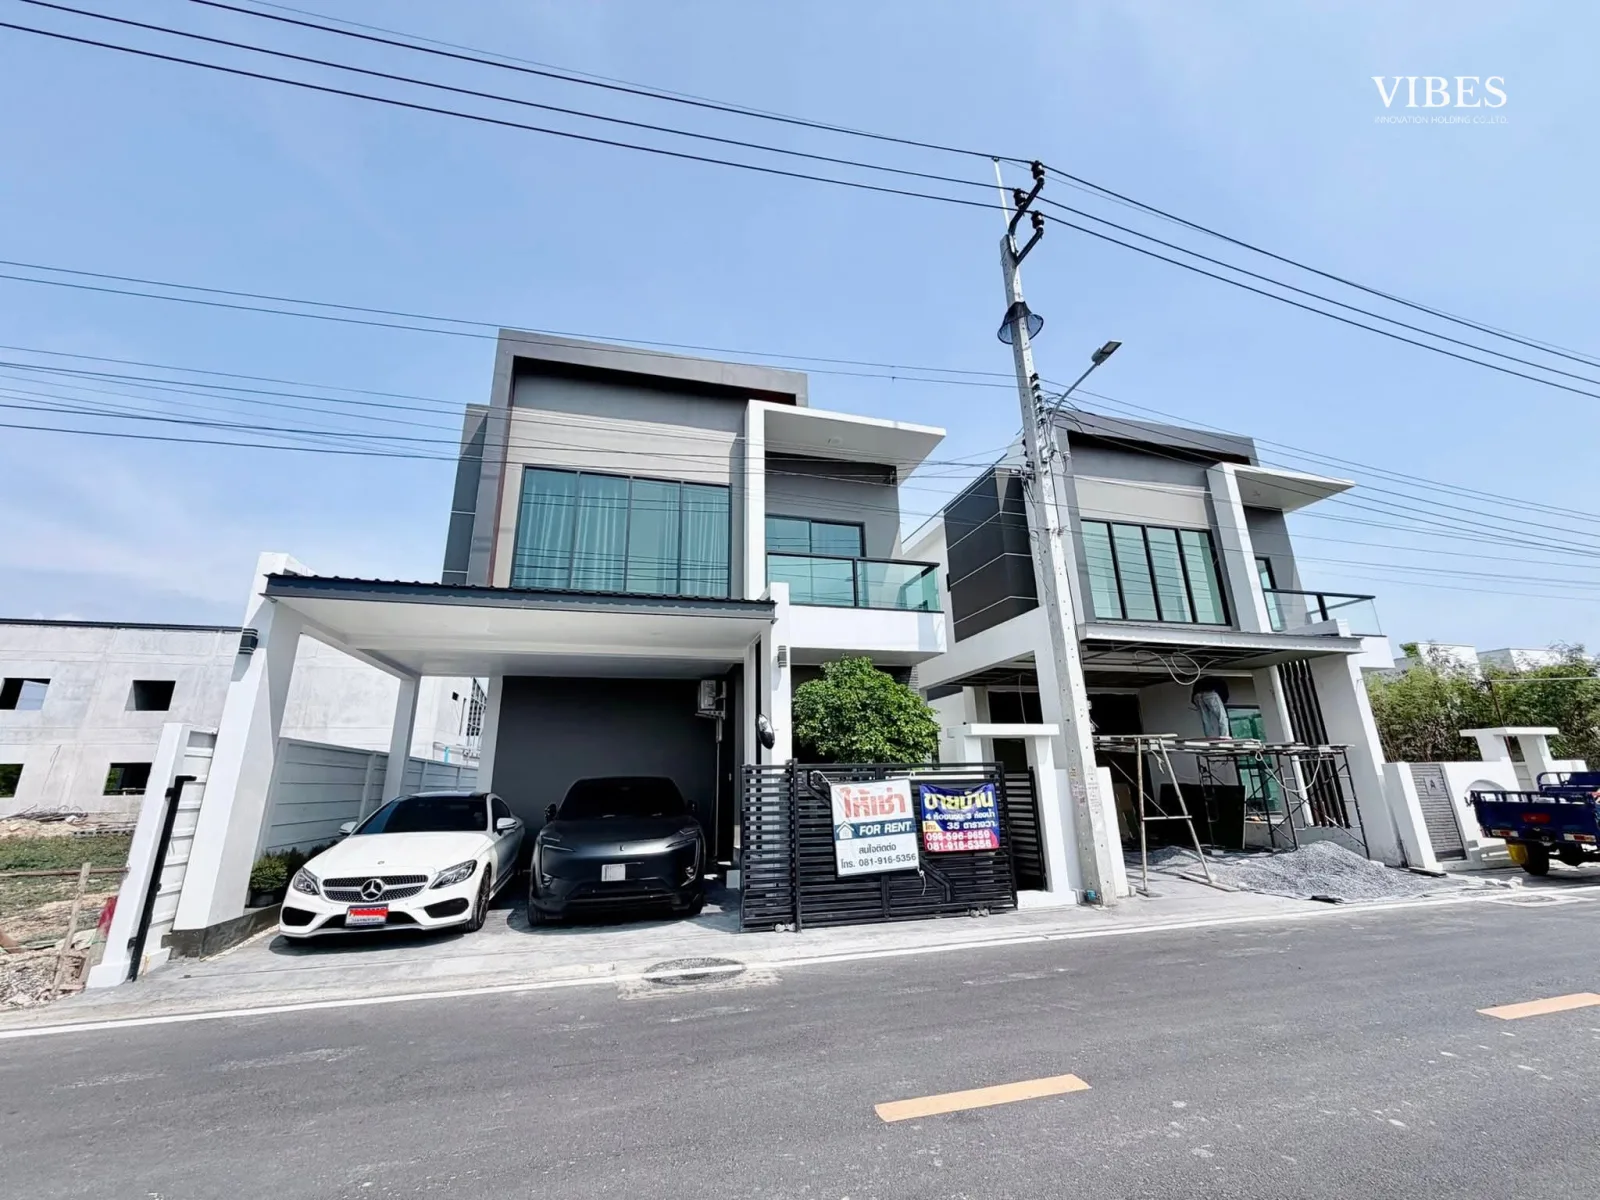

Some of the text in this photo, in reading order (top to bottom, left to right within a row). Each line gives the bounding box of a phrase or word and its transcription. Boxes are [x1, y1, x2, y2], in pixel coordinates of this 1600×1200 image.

[840, 787, 906, 818] ให้เช่า
[923, 791, 994, 810] ขายบ้าน
[859, 821, 912, 836] FOR RENT
[946, 822, 960, 830] 35
[858, 853, 917, 867] 081-916-5356
